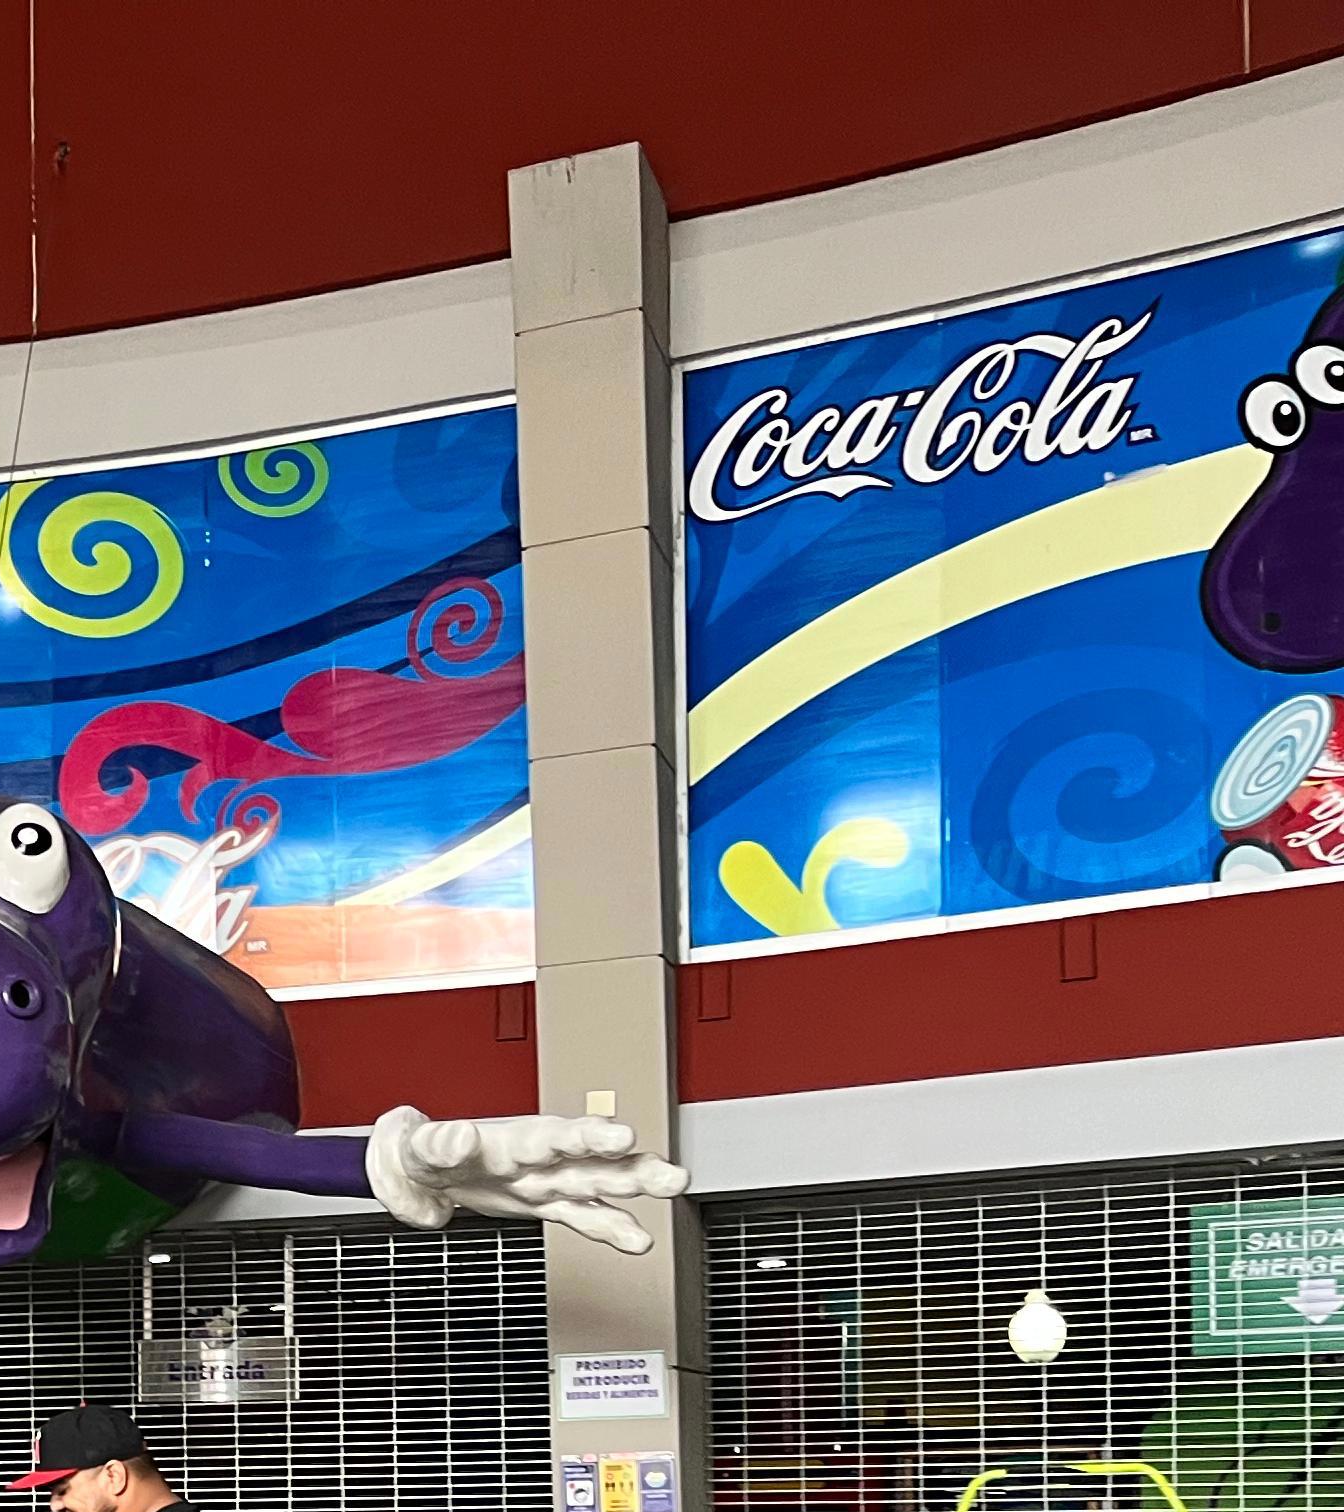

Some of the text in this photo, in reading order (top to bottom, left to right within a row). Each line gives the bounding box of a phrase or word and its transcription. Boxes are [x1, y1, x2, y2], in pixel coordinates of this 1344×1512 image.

[688, 311, 1152, 522] Coca-Cola
[575, 1359, 647, 1371] PROHIBIDO
[573, 1374, 650, 1386] INTRODUCIR
